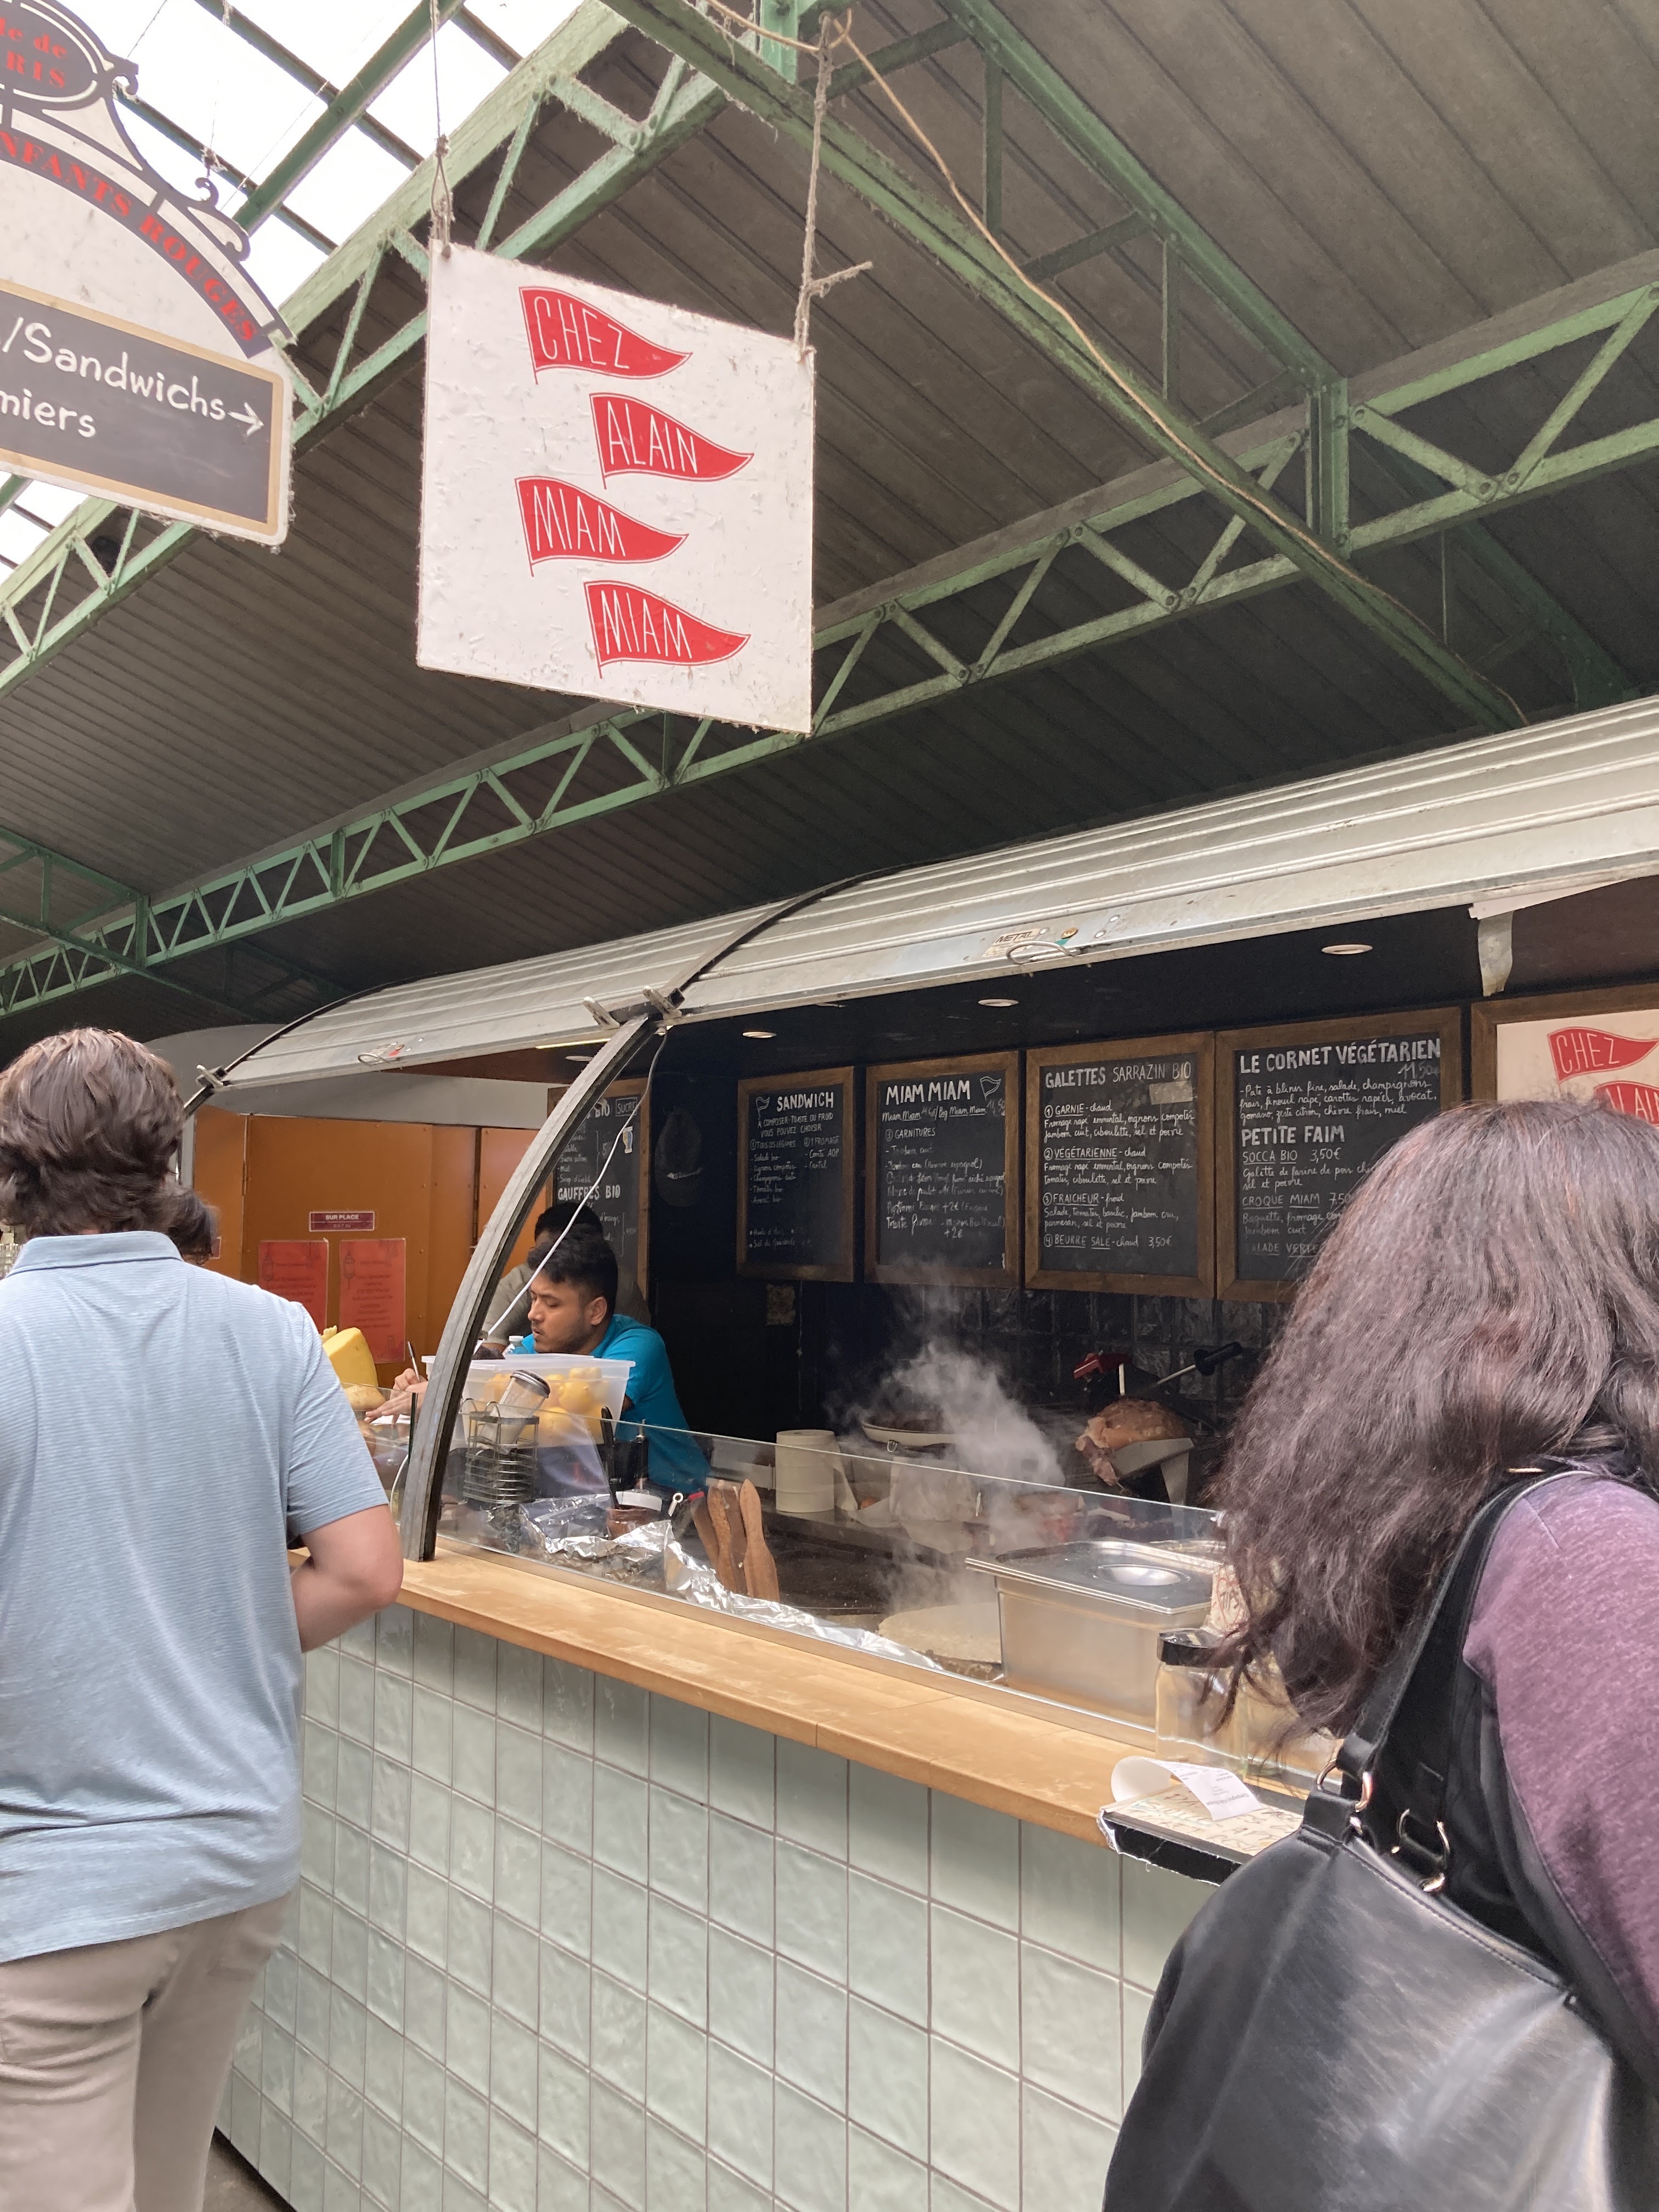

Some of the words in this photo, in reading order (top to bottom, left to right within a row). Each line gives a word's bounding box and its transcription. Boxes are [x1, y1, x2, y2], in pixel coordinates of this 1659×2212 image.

[34, 34, 67, 59] de
[139, 215, 257, 341] ROUGES
[534, 295, 630, 370] CHEZ
[607, 400, 698, 474] ALAIN
[533, 486, 626, 557] MIAM
[601, 589, 692, 659] MIAM
[1240, 1054, 1260, 1074] LE
[1266, 1046, 1332, 1072] CORNET
[1335, 1038, 1441, 1065] VÉGÉTARIEN
[1556, 1032, 1620, 1074] CHEZ
[1045, 1066, 1106, 1088] GALETTES
[1113, 1063, 1165, 1082] SARRAZIN
[1172, 1062, 1191, 1080] BIO
[886, 1084, 925, 1105] MIAM
[928, 1080, 970, 1101] MIAM
[1267, 1085, 1273, 1094] à
[1276, 1082, 1303, 1093] blinis
[1307, 1080, 1327, 1093] fine,
[1328, 1080, 1359, 1092] salade,
[1363, 1078, 1432, 1094] champignons
[777, 1092, 834, 1113] SANDWICH
[1055, 1103, 1085, 1116] GARNIE
[1239, 1098, 1263, 1113] frais,
[1324, 1092, 1359, 1103] carottes
[818, 1112, 833, 1121] FROID
[882, 1111, 902, 1121] Miam
[902, 1110, 922, 1121] Miam
[949, 1106, 968, 1116] Miam
[969, 1105, 986, 1115] Miam
[1044, 1119, 1072, 1131] Fromage
[1161, 1109, 1195, 1126] compotés
[1276, 1109, 1293, 1123] zeste
[1295, 1106, 1321, 1119] citron,
[1324, 1106, 1352, 1115] chèvre
[1356, 1104, 1383, 1120] frais,
[1384, 1104, 1407, 1114] miel
[760, 1128, 774, 1138] VOUS
[777, 1126, 797, 1137] POUVEZ
[800, 1124, 822, 1133] CHOISIR
[895, 1127, 935, 1139] GARNITURES
[1093, 1126, 1132, 1138] ciboulette,
[1133, 1126, 1147, 1136] sel
[1149, 1126, 1156, 1136] et
[1159, 1128, 1184, 1142] poivre
[1242, 1126, 1297, 1147] PETITE
[1304, 1125, 1345, 1143] FAIM
[815, 1136, 840, 1145] FROMAGE
[827, 1148, 839, 1158] AOP
[1054, 1146, 1118, 1159] VÉGÉTARIENNE
[1124, 1146, 1146, 1157] chaud
[1243, 1150, 1276, 1163] SOCCA
[1280, 1150, 1297, 1161] BIO
[1310, 1147, 1341, 1164] 3,50€
[1044, 1163, 1072, 1176] Fromage
[1158, 1158, 1193, 1175] compotés
[1243, 1165, 1275, 1177] Galette
[1279, 1166, 1289, 1176] de
[1291, 1166, 1318, 1178] farine
[1319, 1163, 1331, 1174] de
[1334, 1166, 1353, 1181] pois
[1073, 1173, 1109, 1186] ciboulette,
[1111, 1174, 1122, 1184] sel
[1124, 1174, 1132, 1184] et
[1135, 1177, 1157, 1190] poivre
[1242, 1178, 1256, 1190] sel
[1261, 1178, 1270, 1188] et
[1274, 1178, 1304, 1193] poivre
[605, 1184, 621, 1199] BIO
[1053, 1193, 1099, 1204] FRAICHEUR
[1242, 1194, 1284, 1207] CROQUE
[1290, 1193, 1321, 1205] MIAM
[1044, 1206, 1071, 1217] Salade,
[1073, 1207, 1101, 1219] tomates,
[1102, 1206, 1128, 1219] basilic,
[1161, 1211, 1179, 1221] cru,
[1242, 1211, 1284, 1227] Baguette,
[1287, 1211, 1324, 1227] fromage
[1044, 1220, 1080, 1232] parmesan,
[1096, 1219, 1103, 1228] et
[1105, 1222, 1126, 1234] poivre
[1288, 1224, 1306, 1234] cuit
[1054, 1234, 1087, 1245] BEURRE
[1149, 1235, 1172, 1249] 3,50€
